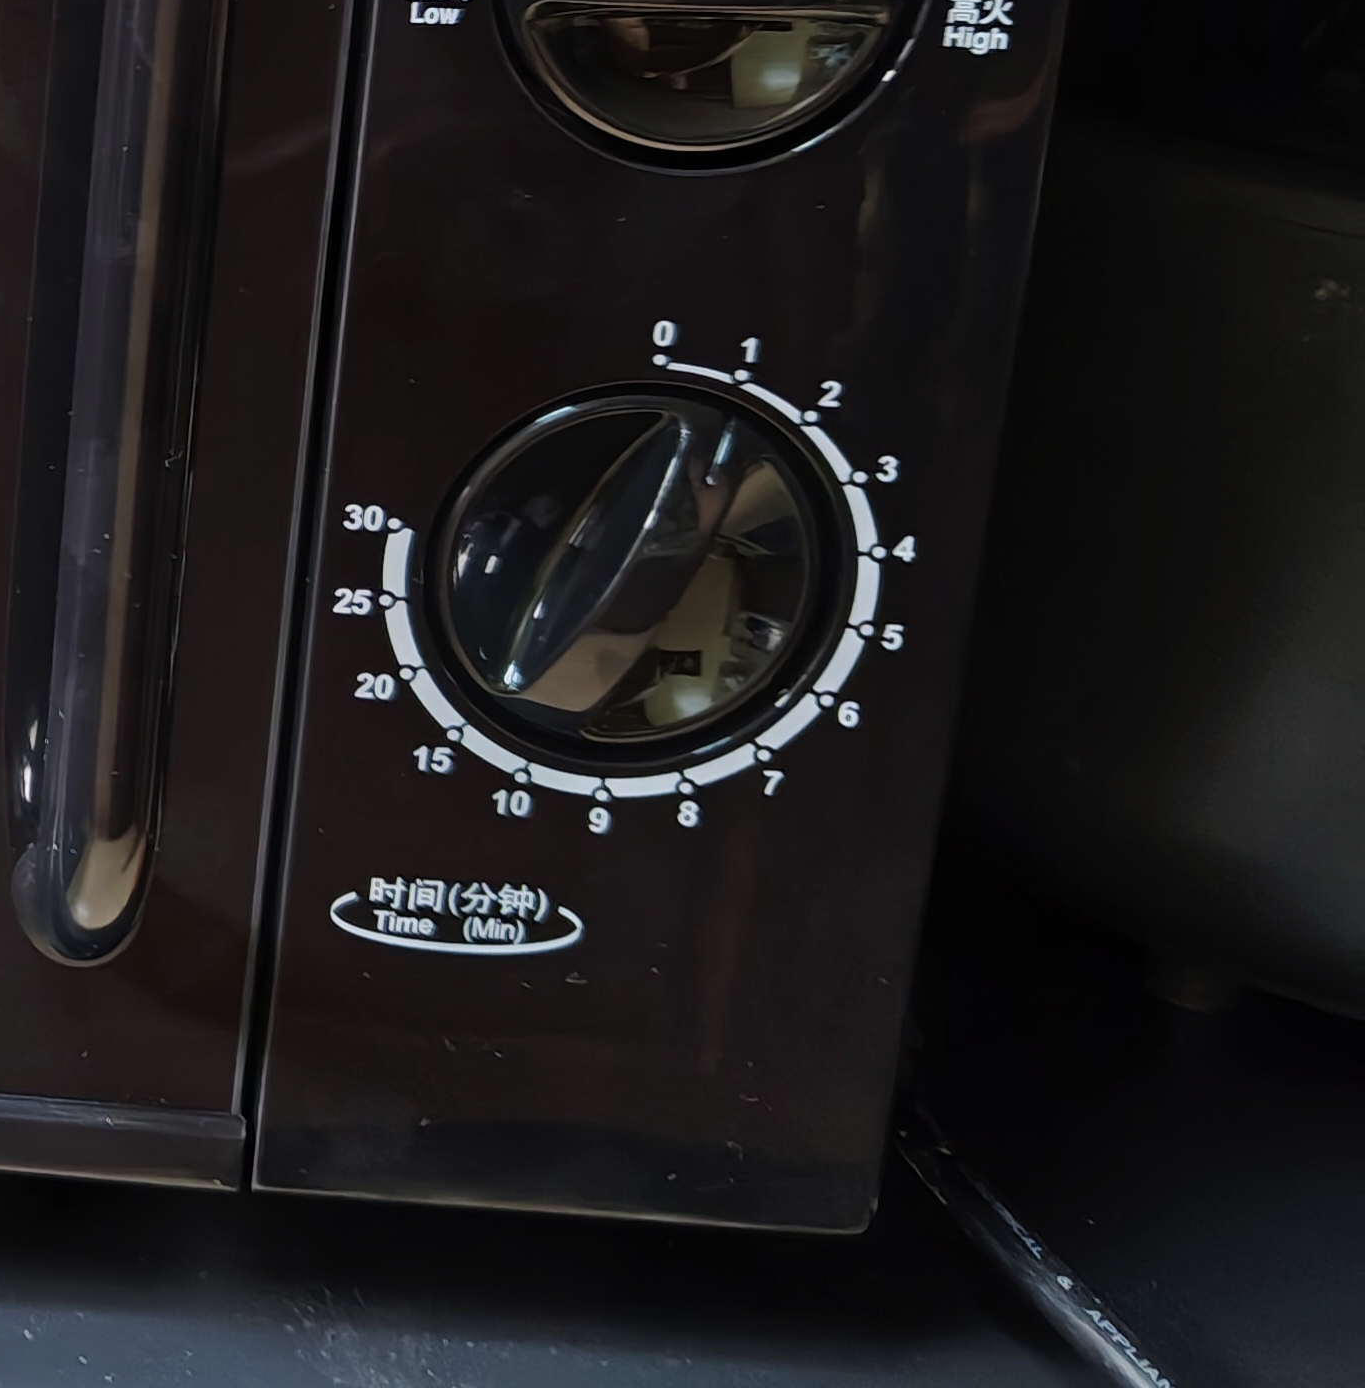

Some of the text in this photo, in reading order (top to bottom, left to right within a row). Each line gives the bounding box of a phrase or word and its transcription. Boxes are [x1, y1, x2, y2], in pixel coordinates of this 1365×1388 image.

[409, 2, 460, 25] Low
[943, 26, 1010, 54] High
[651, 320, 677, 347] 0
[740, 337, 761, 363] 1
[818, 380, 843, 408] 2
[874, 455, 901, 483] 3
[342, 505, 384, 531] 30
[891, 536, 917, 562] 4
[332, 588, 373, 615] 25
[880, 623, 905, 651] 5
[354, 673, 395, 701] 20
[836, 701, 861, 728] 6
[412, 746, 454, 773] 15
[763, 770, 785, 797] 7
[491, 790, 532, 817] 10
[677, 801, 701, 828] 8
[587, 807, 612, 834] 9
[373, 909, 526, 945] Time (Min)
